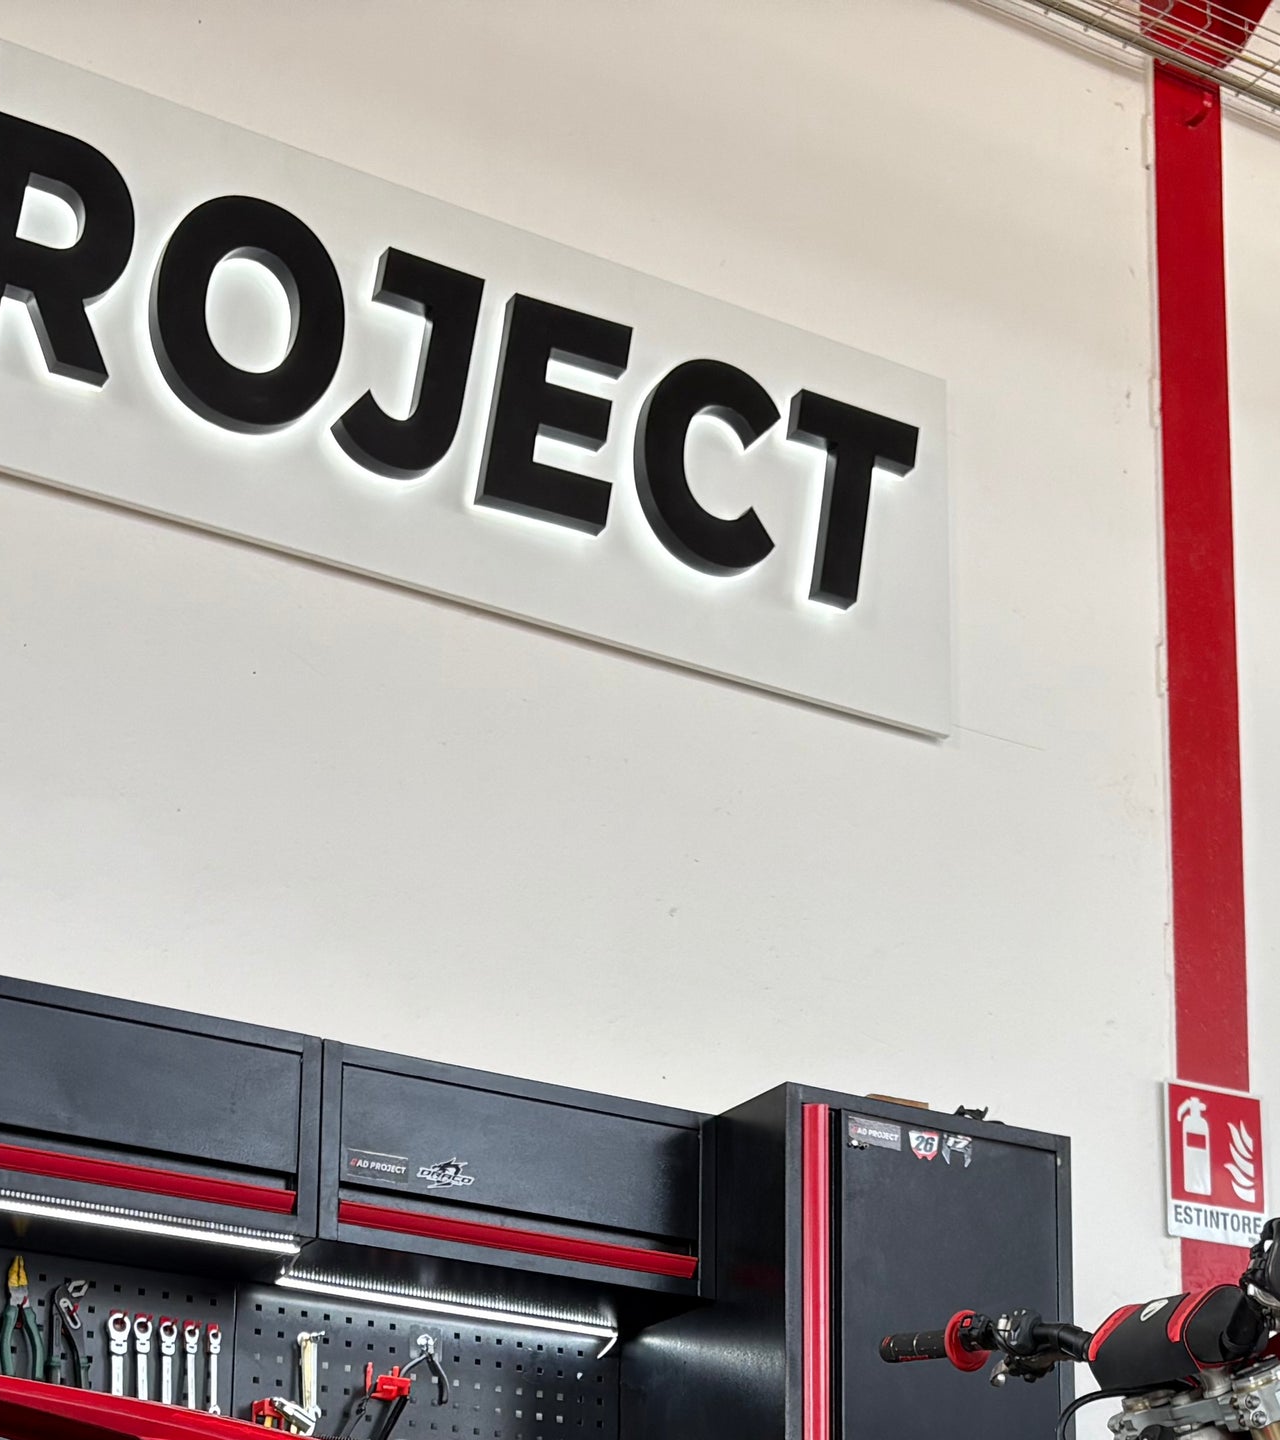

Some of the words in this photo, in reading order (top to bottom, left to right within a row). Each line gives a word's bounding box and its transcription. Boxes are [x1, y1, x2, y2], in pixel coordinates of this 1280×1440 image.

[868, 1129, 900, 1142] PROJECT
[915, 1134, 936, 1153] 26
[370, 1161, 407, 1175] PROJECT
[1173, 1204, 1263, 1235] ESTINTORE
